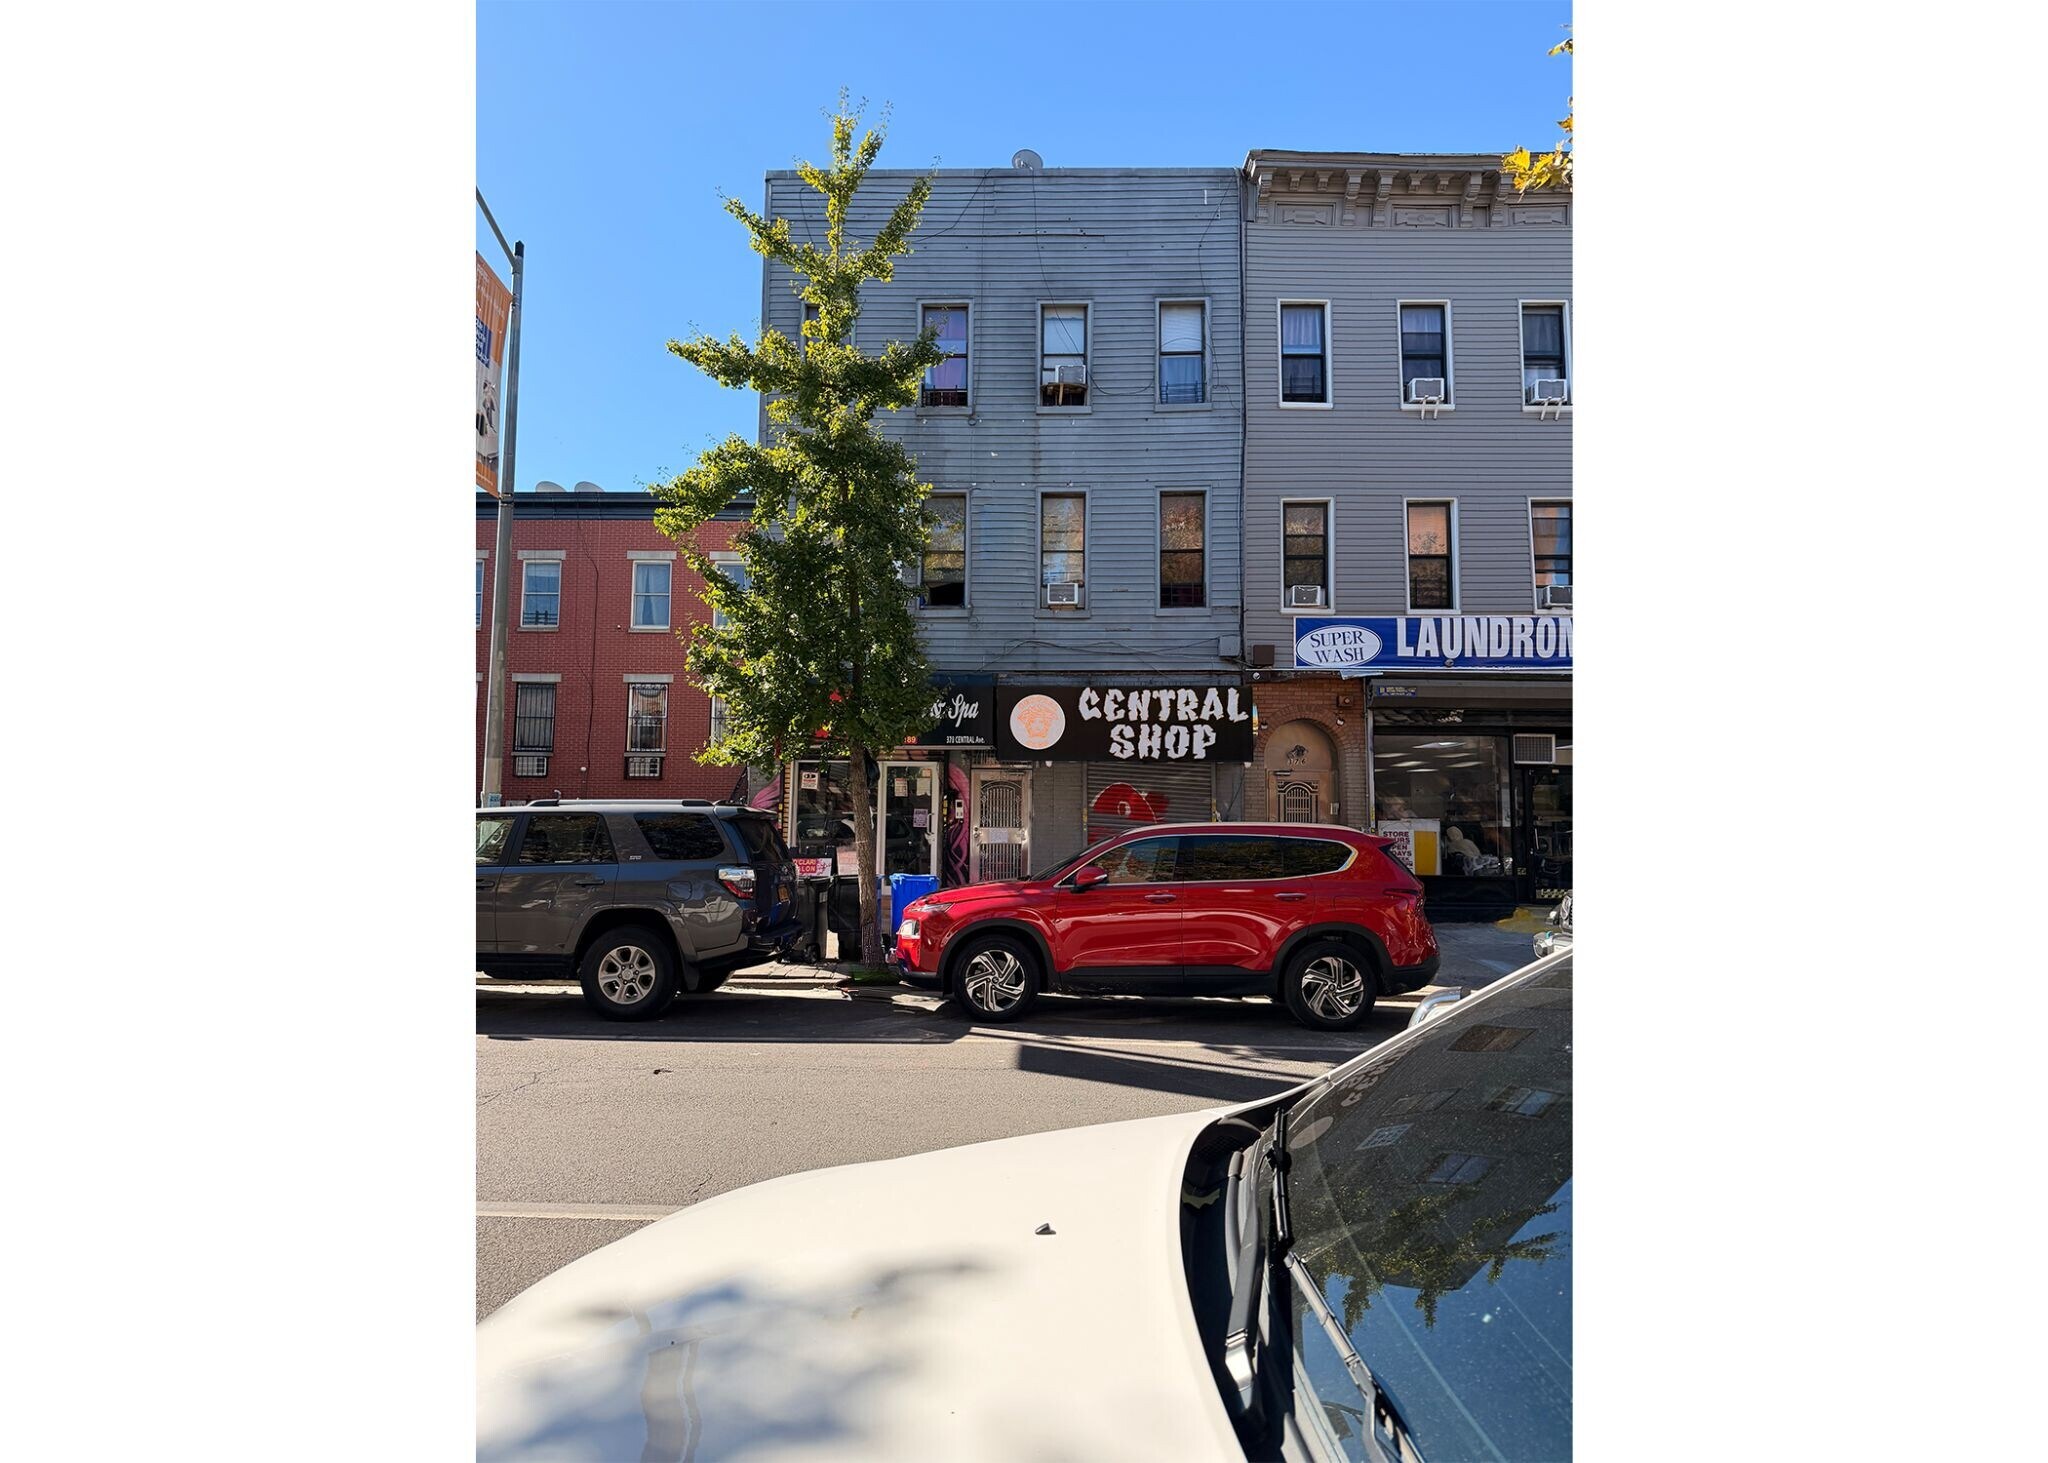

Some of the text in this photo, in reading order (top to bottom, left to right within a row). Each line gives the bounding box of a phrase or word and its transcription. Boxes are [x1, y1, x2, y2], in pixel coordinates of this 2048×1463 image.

[1310, 630, 1365, 649] SUPER
[1314, 647, 1365, 664] WASH
[948, 693, 979, 728] Spa
[1078, 686, 1250, 723] CENTRAL
[955, 735, 975, 744] CENTRAL
[1109, 723, 1217, 760] SHOP
